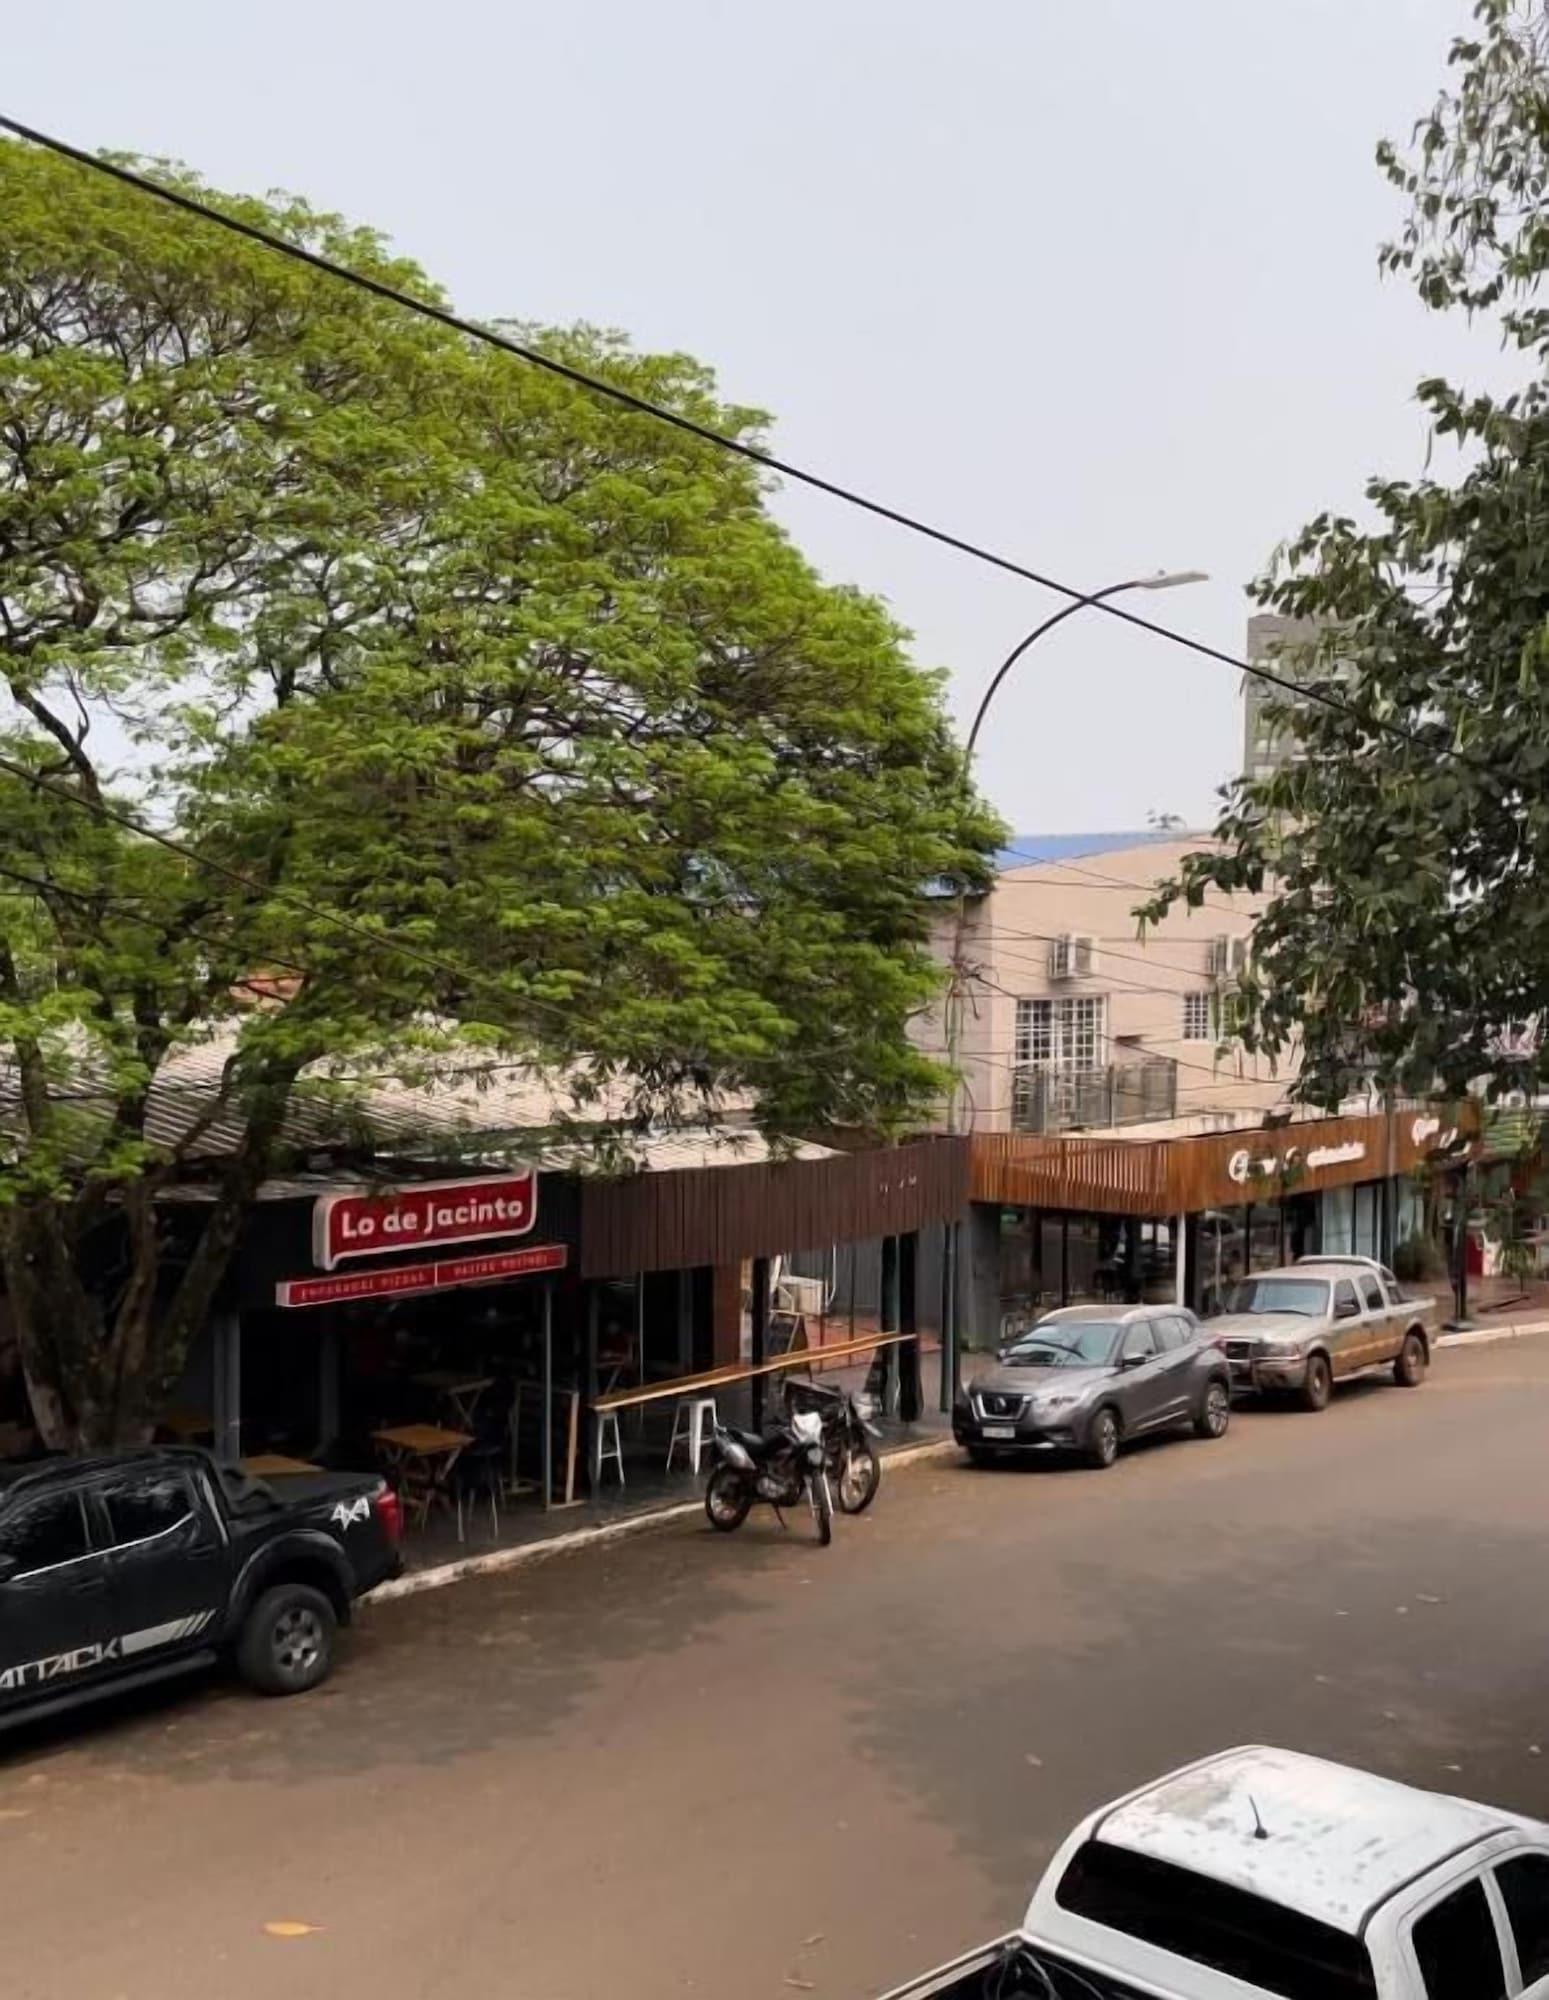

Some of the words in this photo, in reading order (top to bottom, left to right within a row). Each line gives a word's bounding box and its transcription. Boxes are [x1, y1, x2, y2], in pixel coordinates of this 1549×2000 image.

[341, 1210, 375, 1239] Lo
[382, 1206, 418, 1233] de
[424, 1197, 523, 1235] Jacinto
[0, 1637, 119, 1689] ATTACK
